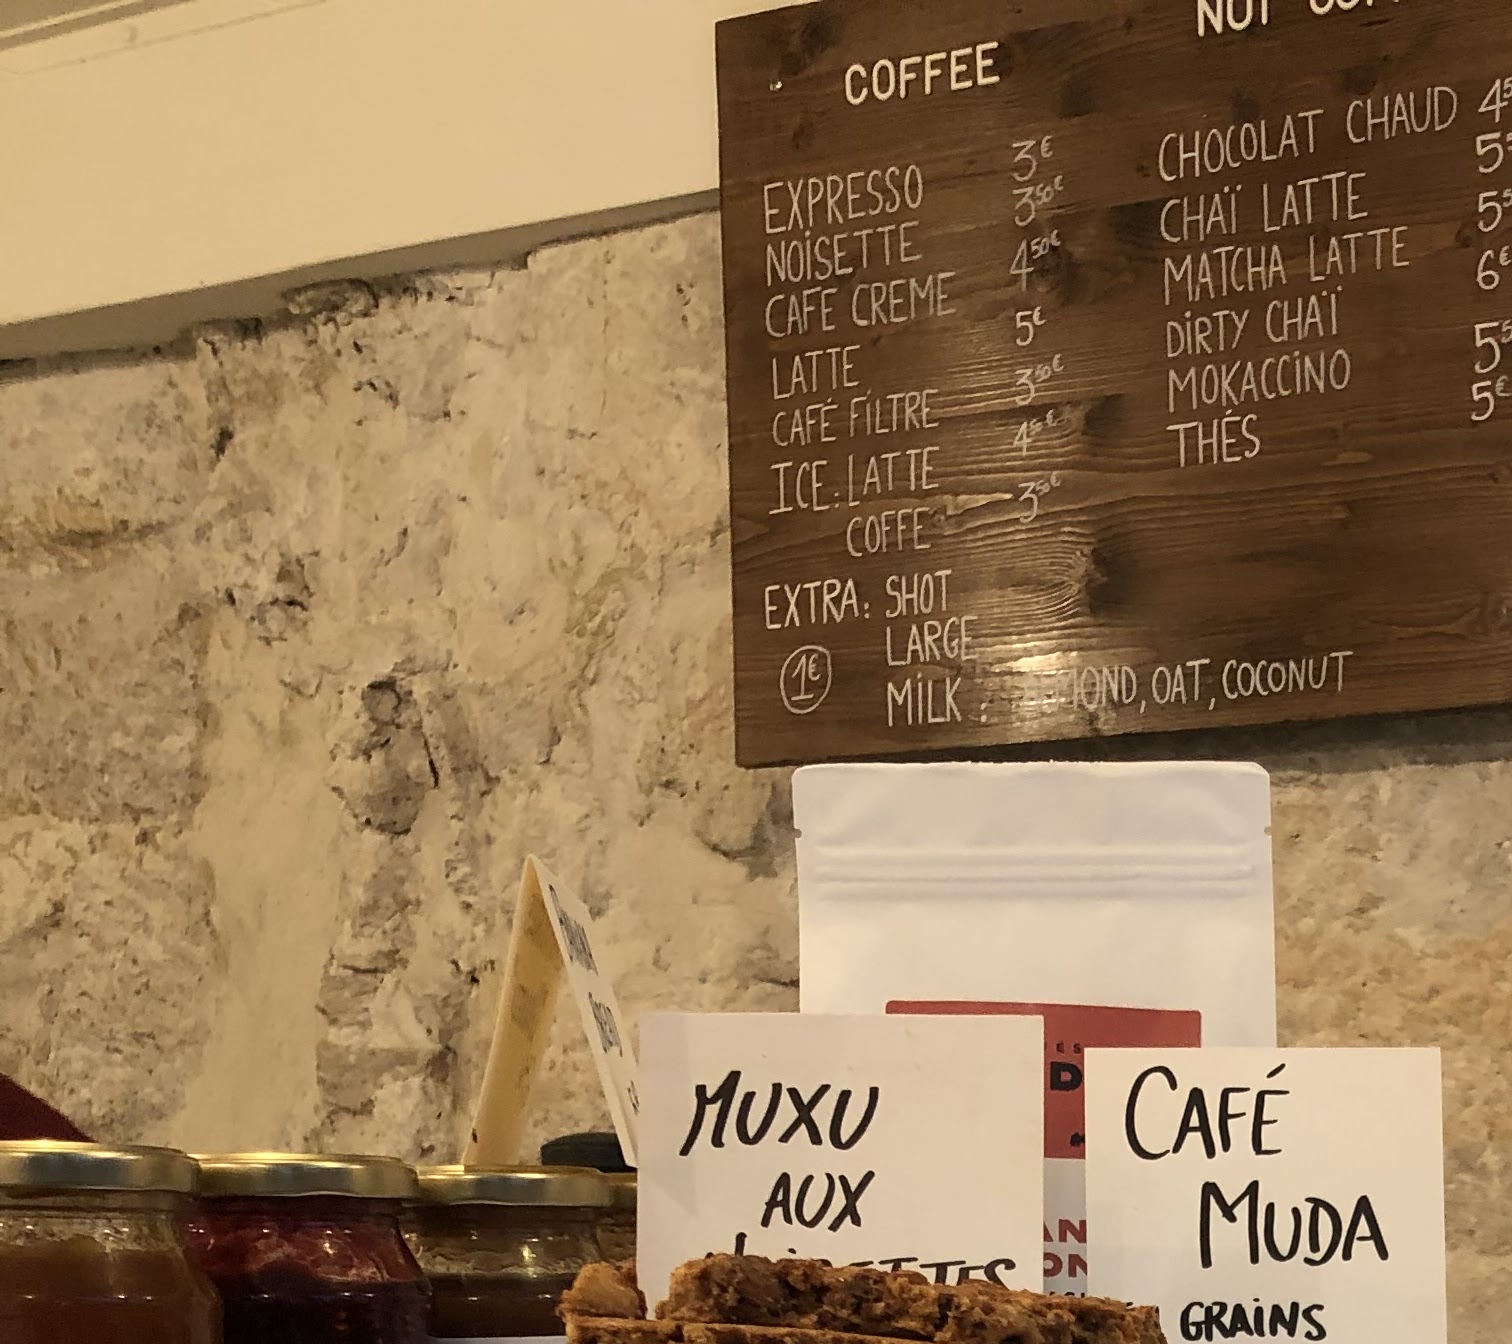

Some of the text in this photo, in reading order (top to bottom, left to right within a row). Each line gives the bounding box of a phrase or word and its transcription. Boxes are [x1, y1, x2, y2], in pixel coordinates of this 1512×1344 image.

[845, 41, 1000, 104] COFFEE
[1158, 109, 1324, 182] CHOCOLAT
[1346, 86, 1458, 144] CHAUD
[764, 136, 1053, 235] EXPRESSO 3€
[1263, 171, 1368, 232] LATTE
[1164, 244, 1286, 305] MATCHA
[1309, 226, 1410, 282] LATTE
[1475, 245, 1512, 290] 6€
[765, 287, 838, 338] CAFE
[852, 272, 956, 327] CREME
[772, 306, 1047, 400] LATTE 5€
[773, 398, 838, 447] CAFÉ
[1167, 375, 1512, 467] THÉS 5€
[848, 446, 940, 507] LATTE
[846, 507, 931, 557] COFFE
[765, 569, 952, 630] EXTRA: SHOT
[885, 616, 979, 667] LARGE
[1222, 651, 1353, 700] COCONUT
[679, 1070, 880, 1157] MUXU
[1125, 1064, 1290, 1160] CAFÉ
[760, 1170, 875, 1233] AUX
[1200, 1180, 1389, 1269] MUDA
